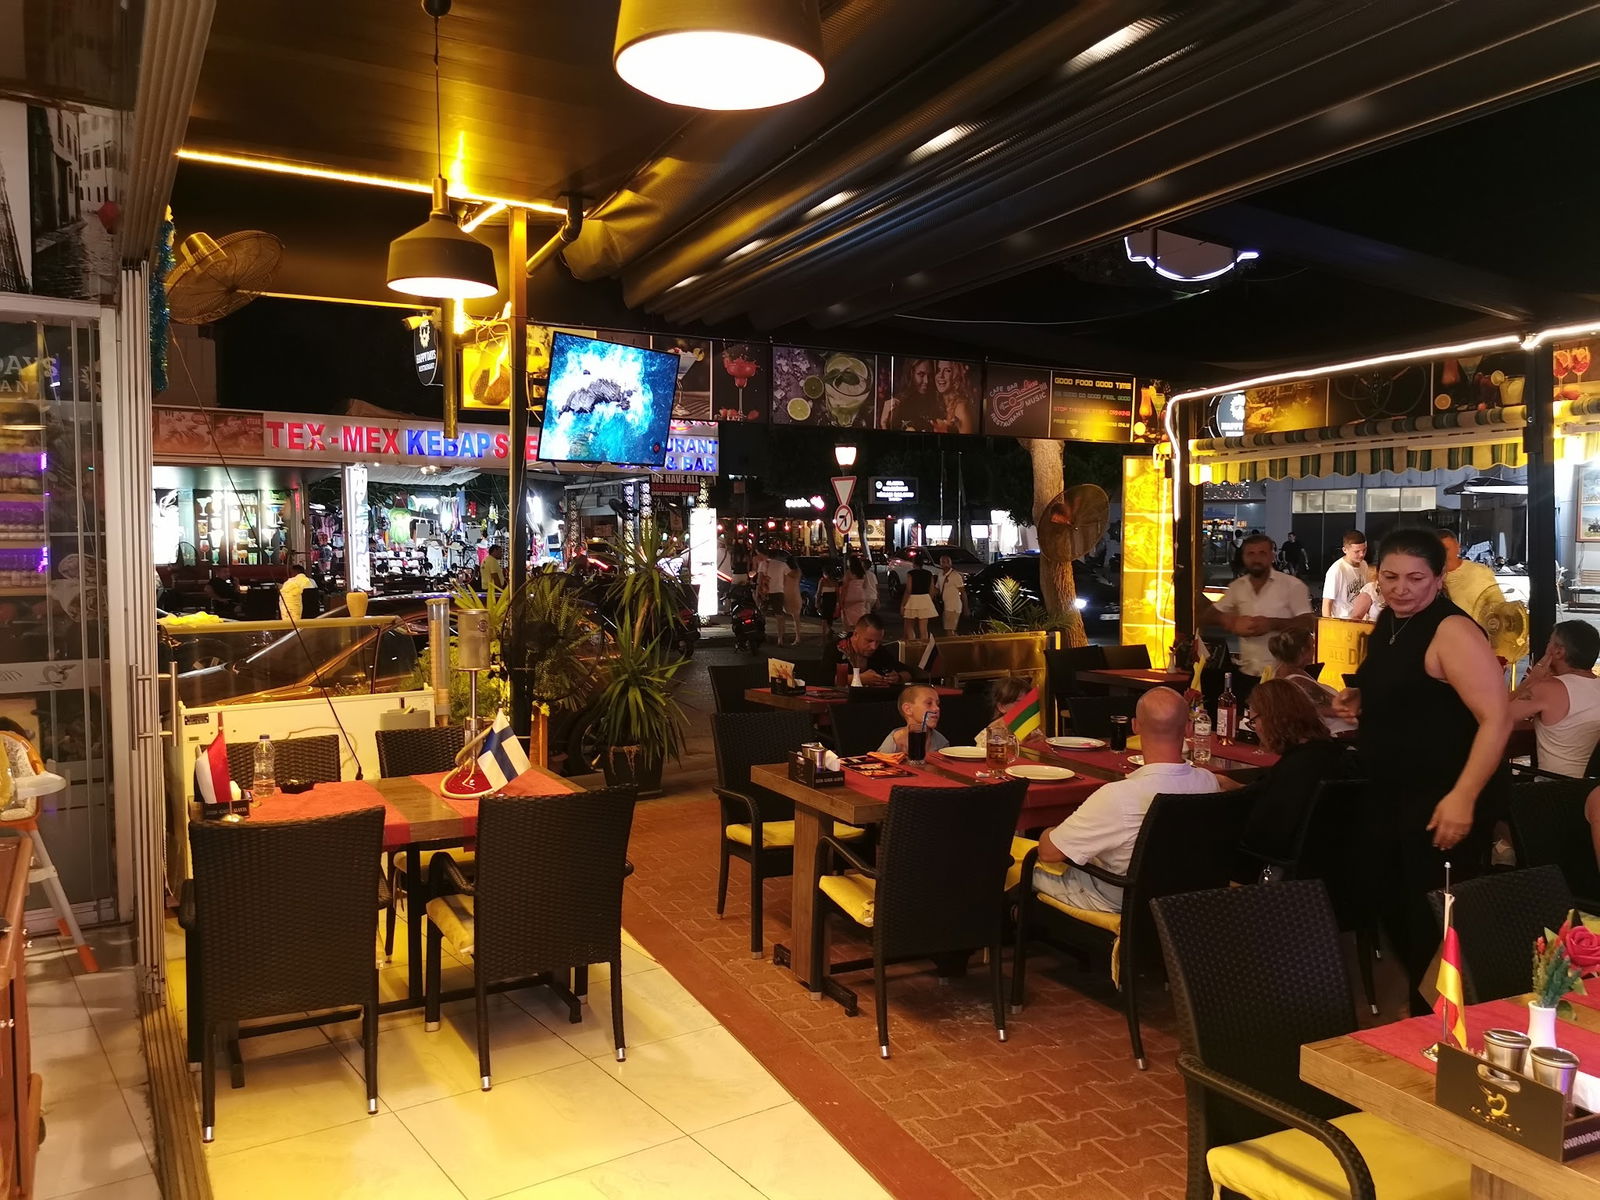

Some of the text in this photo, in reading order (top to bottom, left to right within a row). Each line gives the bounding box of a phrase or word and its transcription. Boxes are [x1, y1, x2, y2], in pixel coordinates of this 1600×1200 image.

[989, 382, 1018, 397] CAFE BAR
[1054, 377, 1073, 385] GOOD
[1075, 378, 1093, 387] FOOD
[1095, 380, 1113, 388] GOOD
[1024, 392, 1047, 407] MUSIC
[989, 408, 1024, 427] RESTAURANT
[406, 429, 490, 458] KEBAP
[667, 438, 717, 454] URANT
[664, 456, 716, 472] & BAR
[651, 474, 699, 484] WE HAVE ALL
